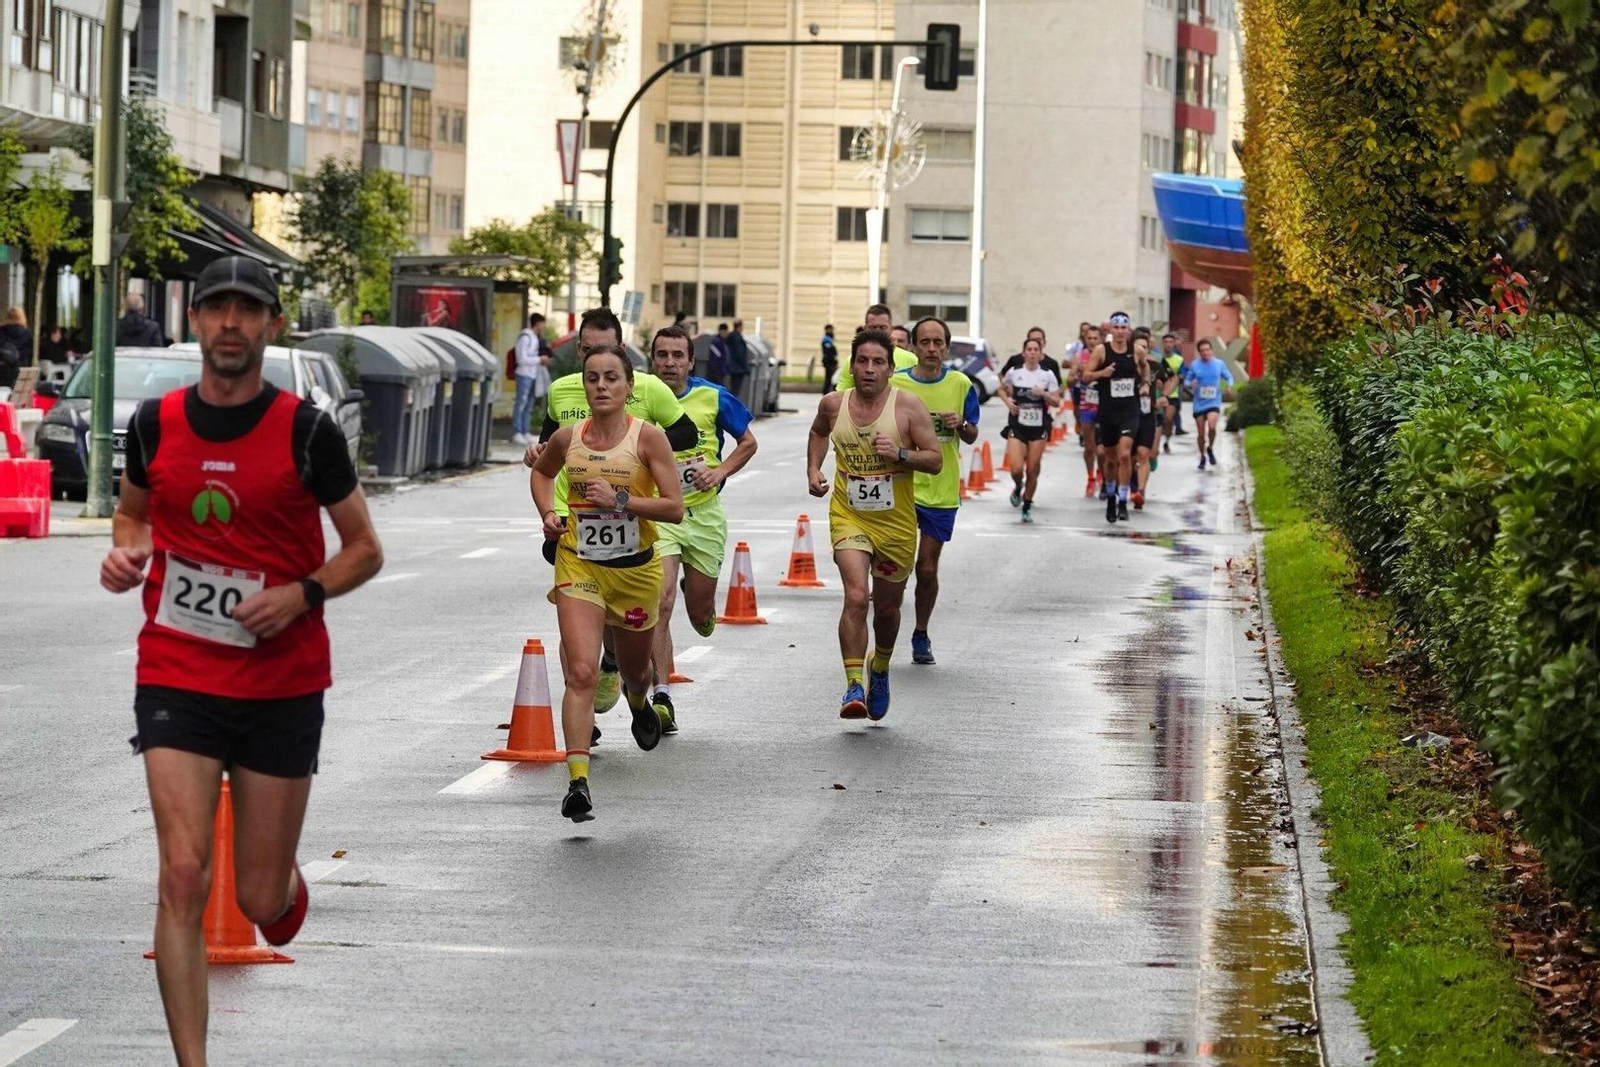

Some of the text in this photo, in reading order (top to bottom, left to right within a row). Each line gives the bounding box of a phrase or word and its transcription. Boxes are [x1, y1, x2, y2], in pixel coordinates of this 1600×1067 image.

[560, 407, 586, 420] máis
[858, 484, 881, 500] 54
[585, 525, 626, 546] 261
[174, 575, 243, 620] 220
